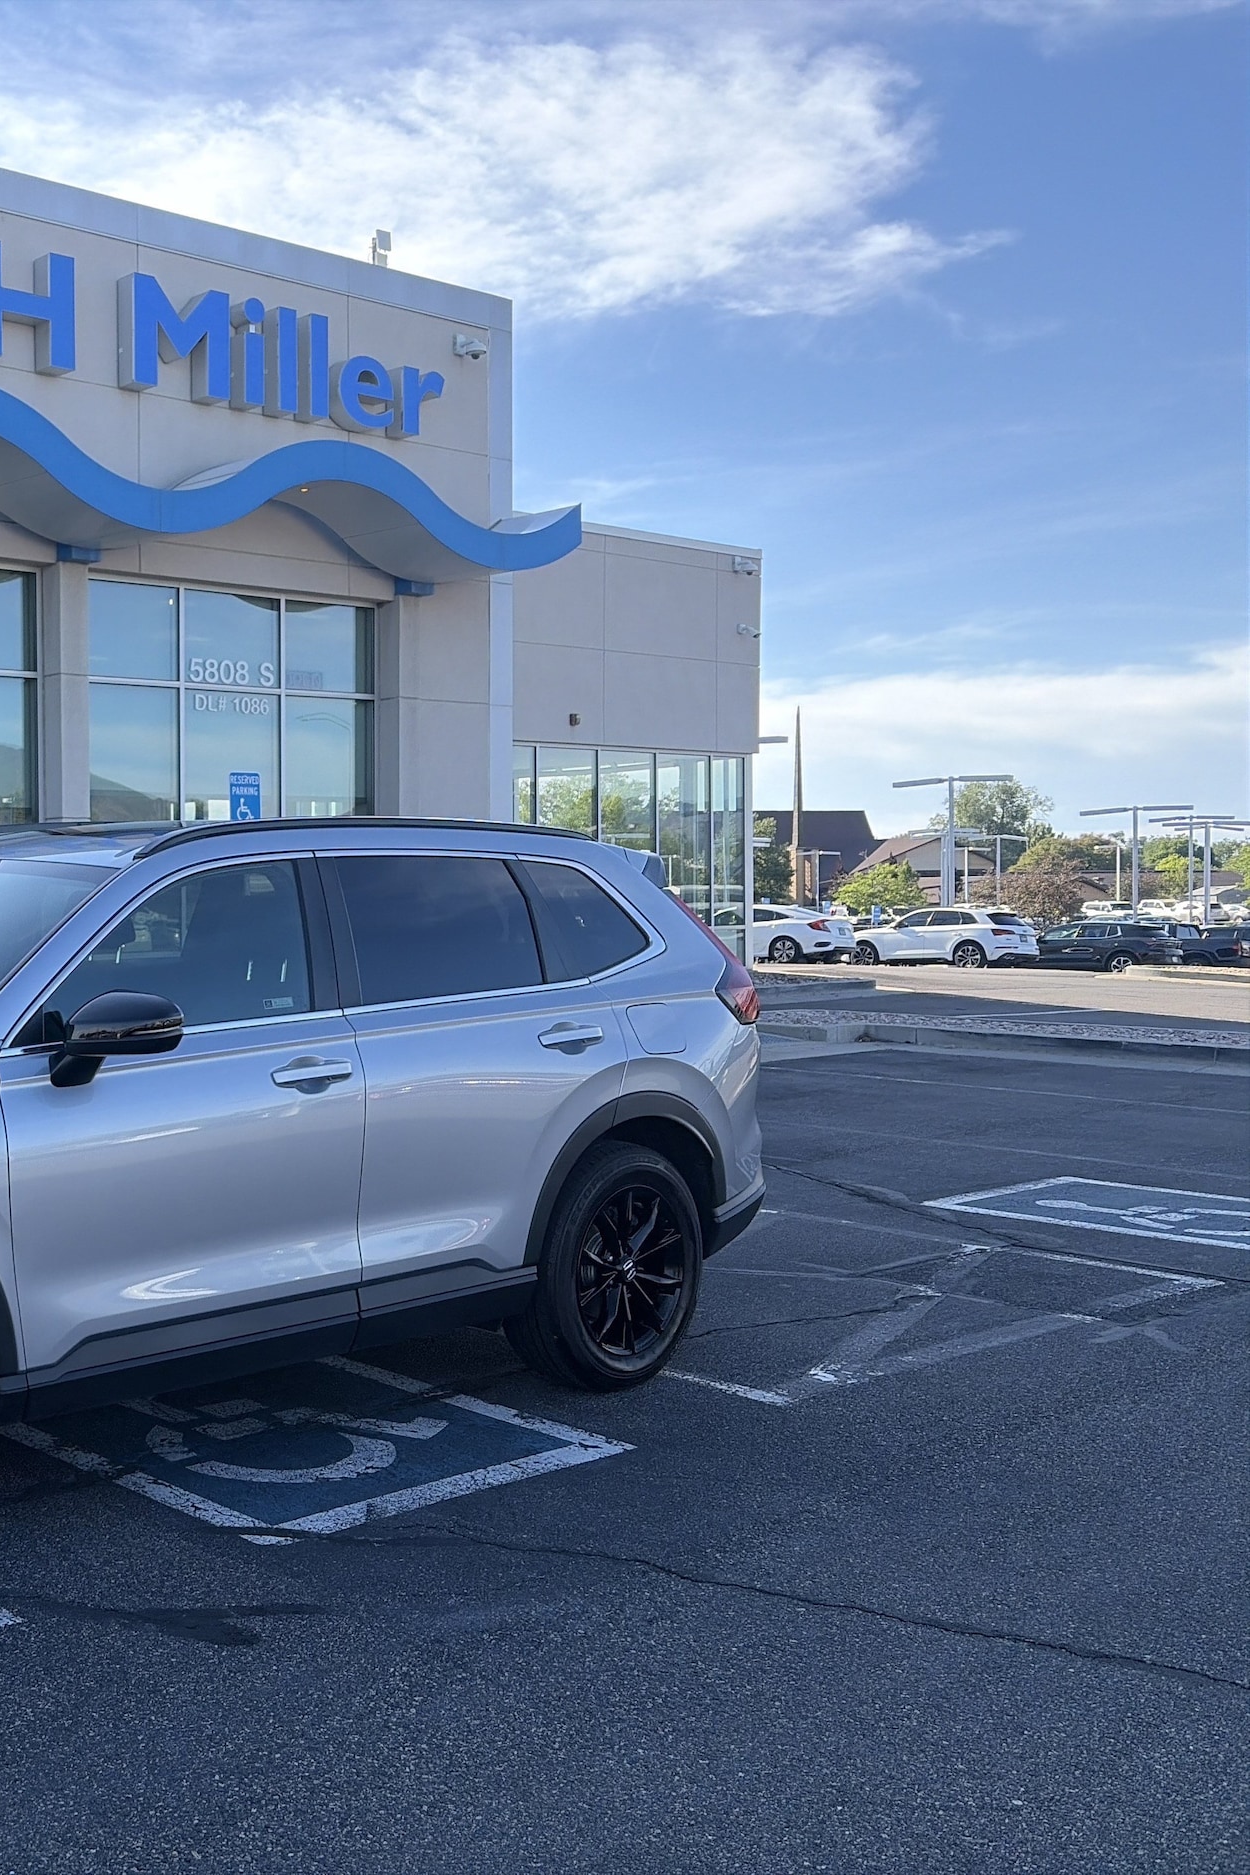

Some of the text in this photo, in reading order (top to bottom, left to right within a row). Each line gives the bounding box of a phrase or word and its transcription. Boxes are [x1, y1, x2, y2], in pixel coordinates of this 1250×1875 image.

[117, 272, 445, 440] Miller
[189, 657, 250, 685] 5808
[259, 662, 275, 688] S
[194, 693, 270, 716] DL# 1086
[230, 774, 259, 785] RESERVED
[231, 786, 259, 796] PARKING
